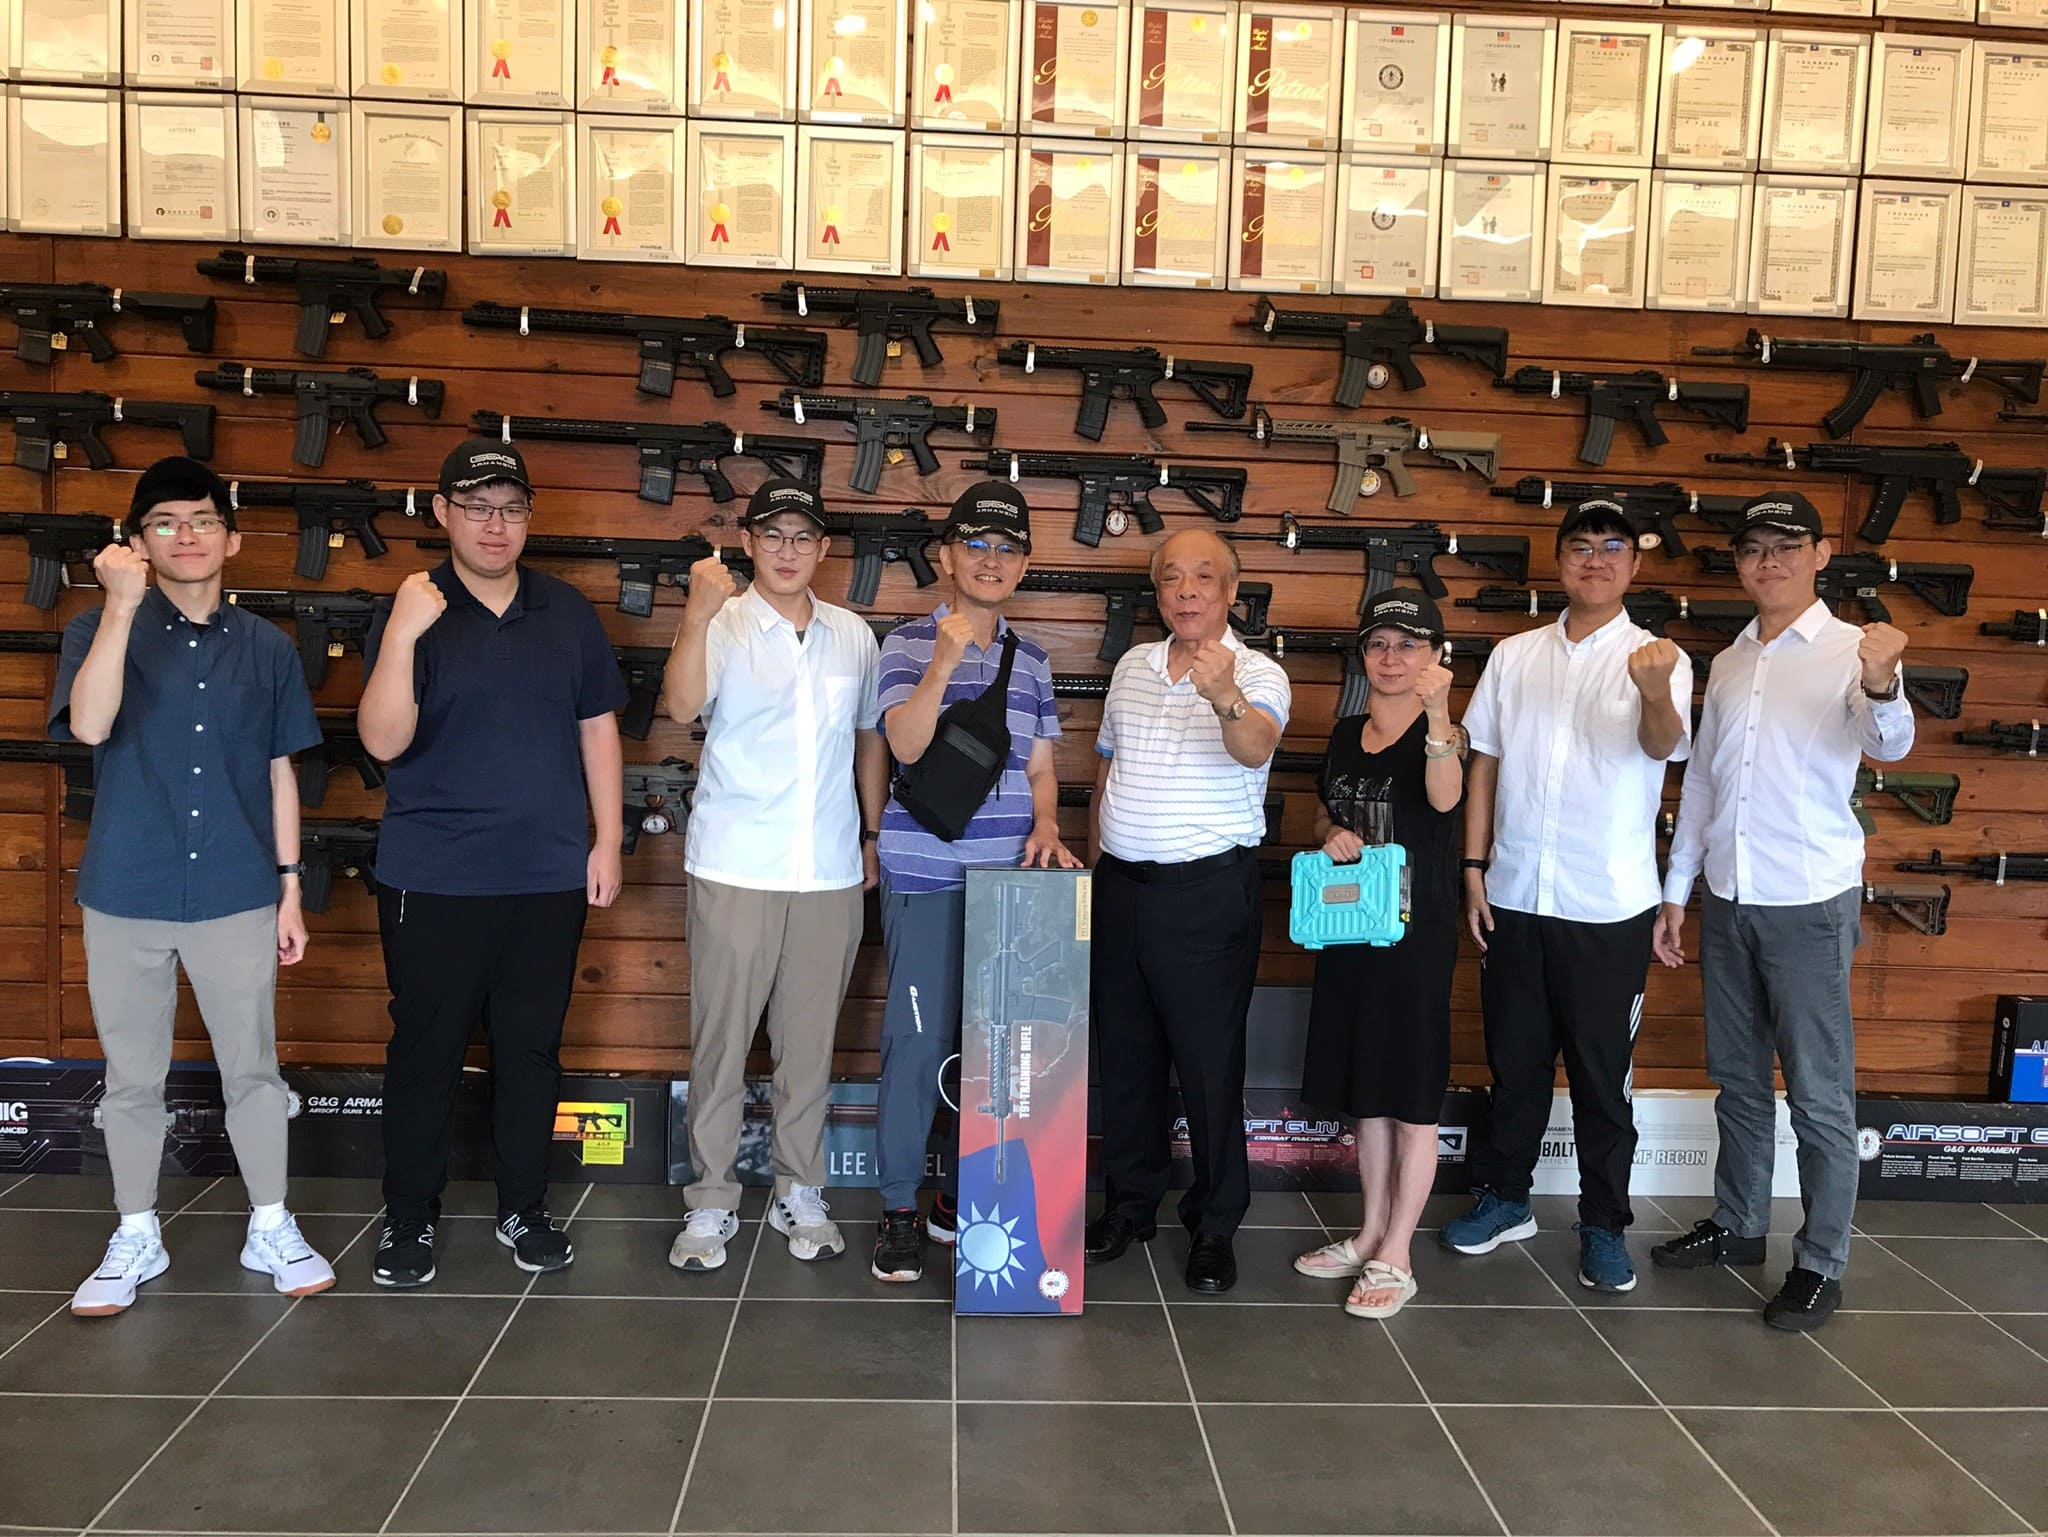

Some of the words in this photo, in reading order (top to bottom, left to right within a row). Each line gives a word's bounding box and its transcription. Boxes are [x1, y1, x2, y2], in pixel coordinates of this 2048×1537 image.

[1021, 1025, 1032, 1051] RIFLE
[1019, 1053, 1031, 1098] TRAINING
[308, 1097, 339, 1107] G&G
[1019, 1101, 1030, 1119] T91
[0, 1102, 29, 1121] IG
[1285, 1121, 1340, 1134] GUN
[1886, 1123, 2027, 1143] AIRSOFT
[1655, 1150, 1707, 1166] RECON
[1943, 1145, 1965, 1153] G&G
[1968, 1146, 2022, 1155] ARMAMENT
[829, 1152, 867, 1176] LEE
